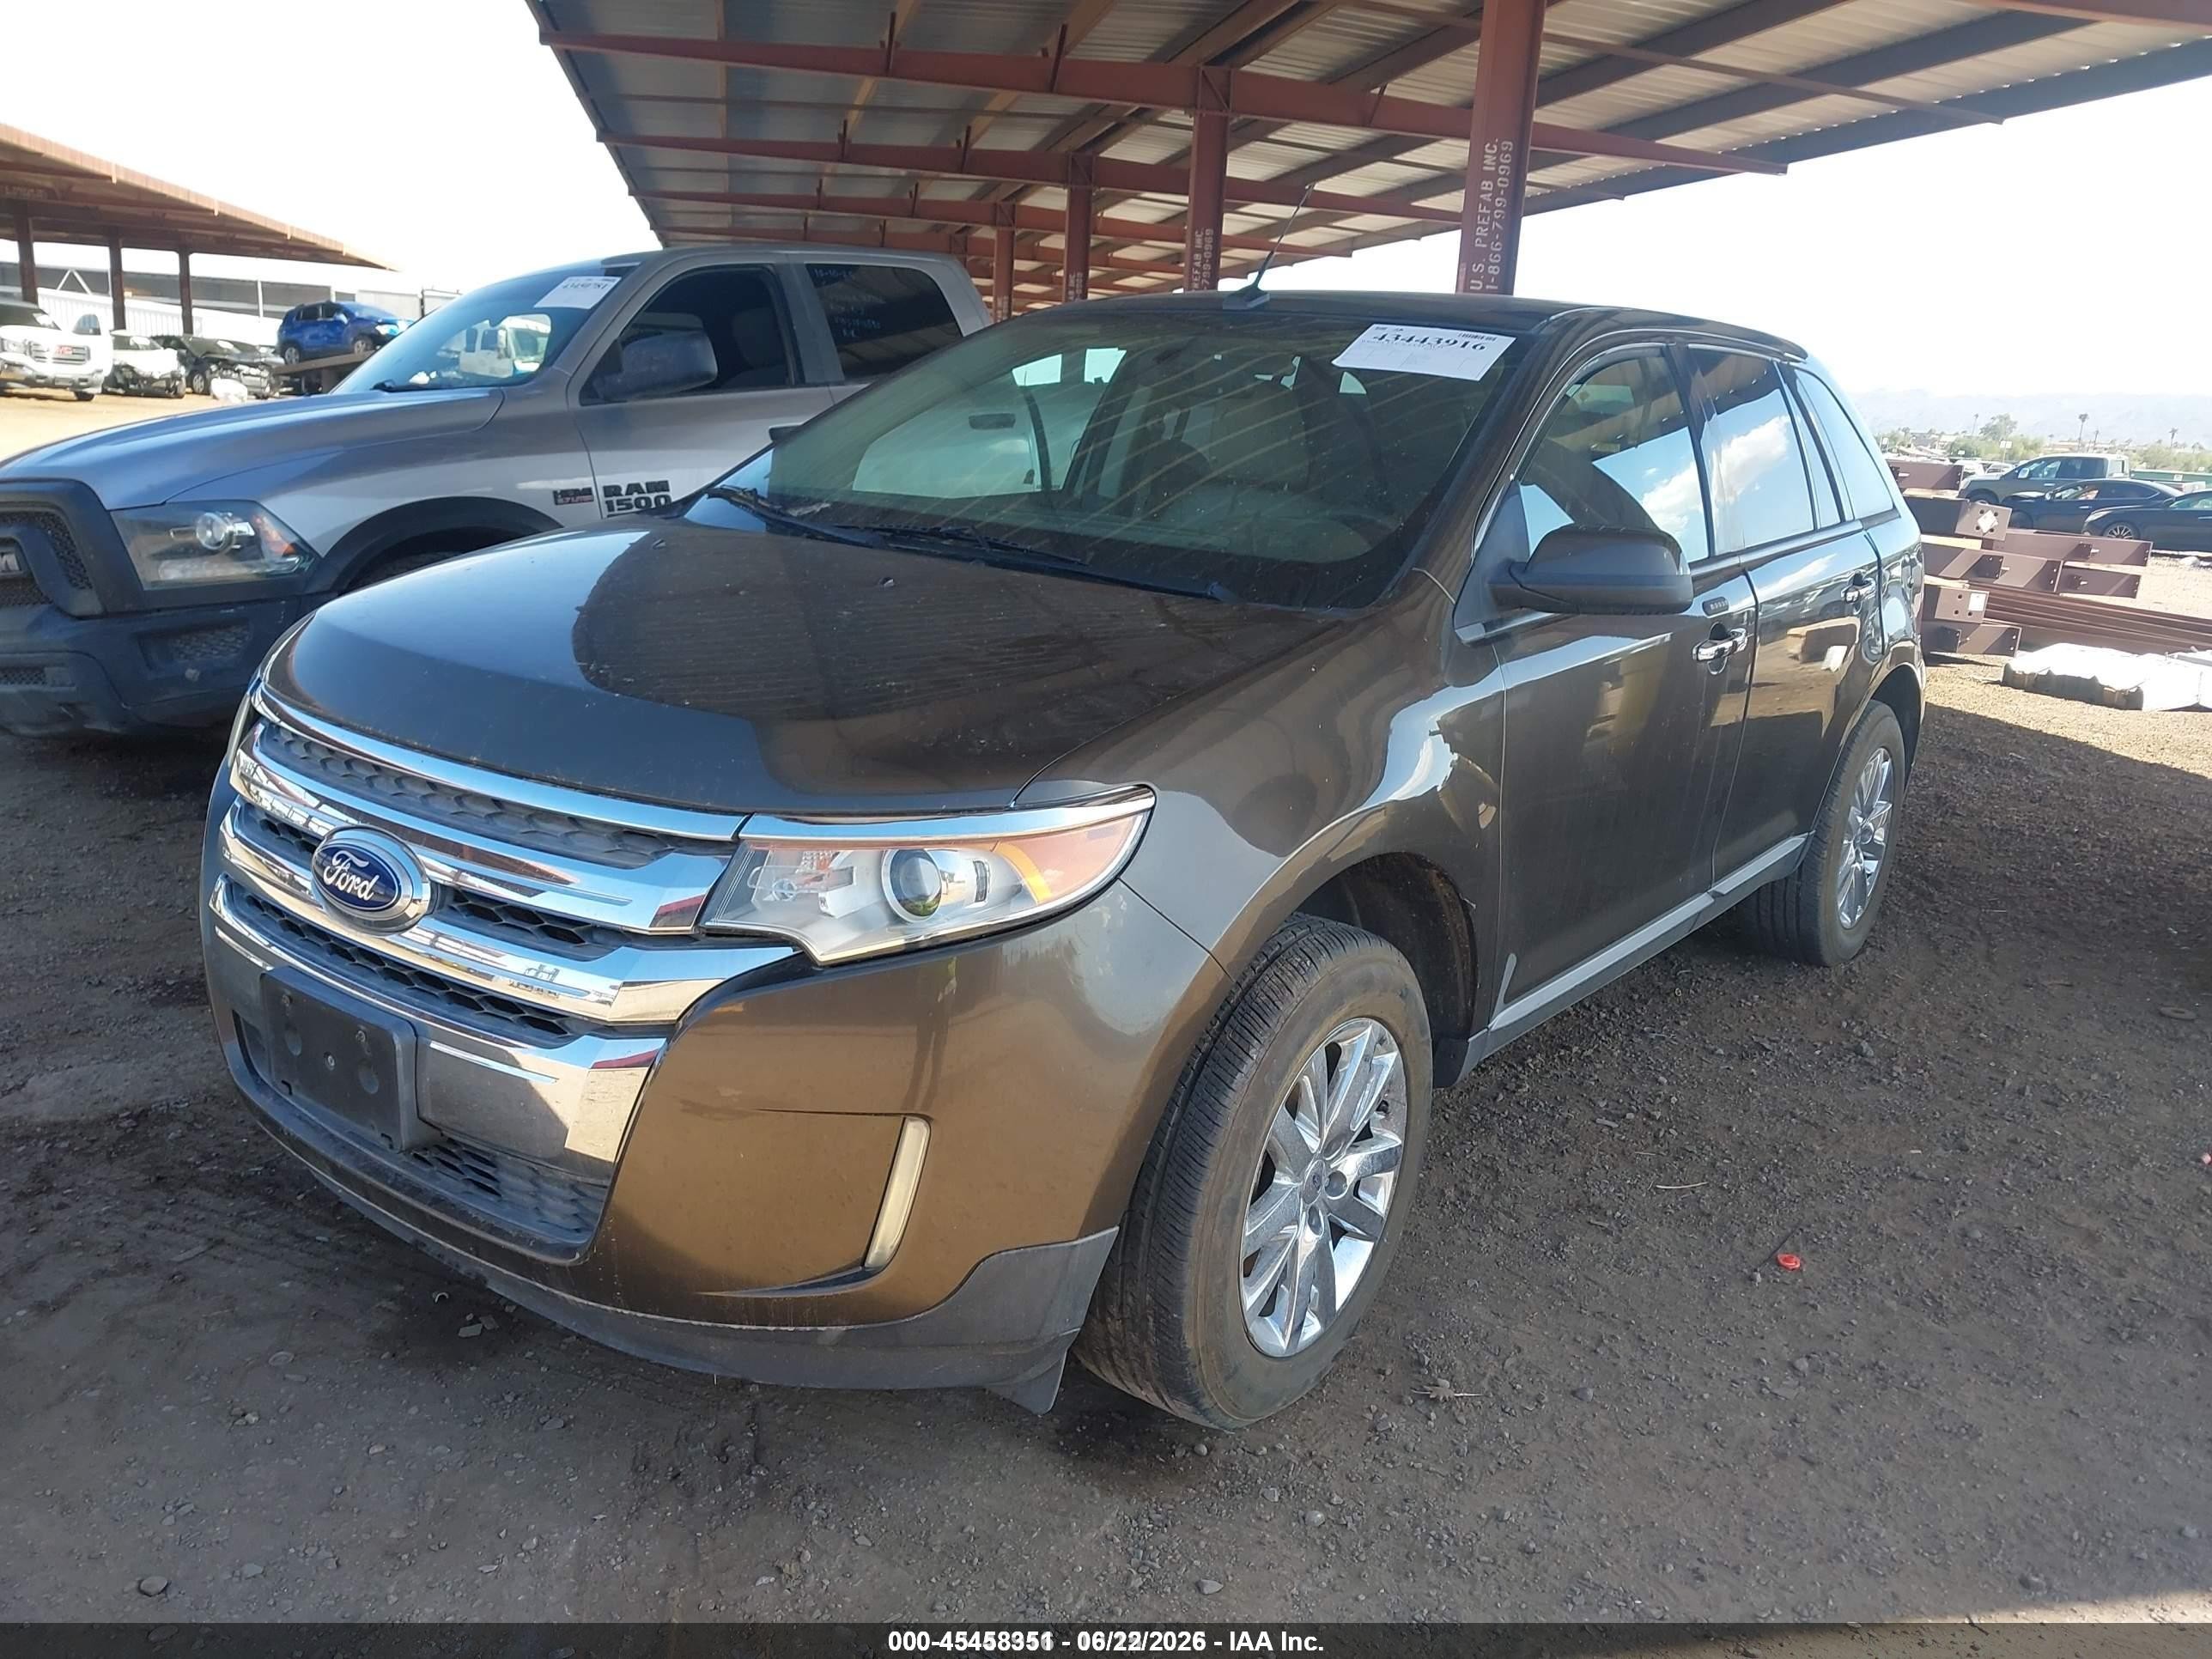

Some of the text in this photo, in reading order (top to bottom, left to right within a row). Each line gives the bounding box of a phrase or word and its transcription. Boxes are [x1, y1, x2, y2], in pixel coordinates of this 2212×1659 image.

[1470, 137, 1498, 290] U.S. PREFAB INC.
[1486, 141, 1514, 290] 1-866-799-0969
[1191, 253, 1201, 290] REFAB
[1373, 332, 1486, 350] 43443916
[603, 480, 670, 497] RAM
[605, 494, 672, 513] 1500
[323, 849, 380, 901] Ford
